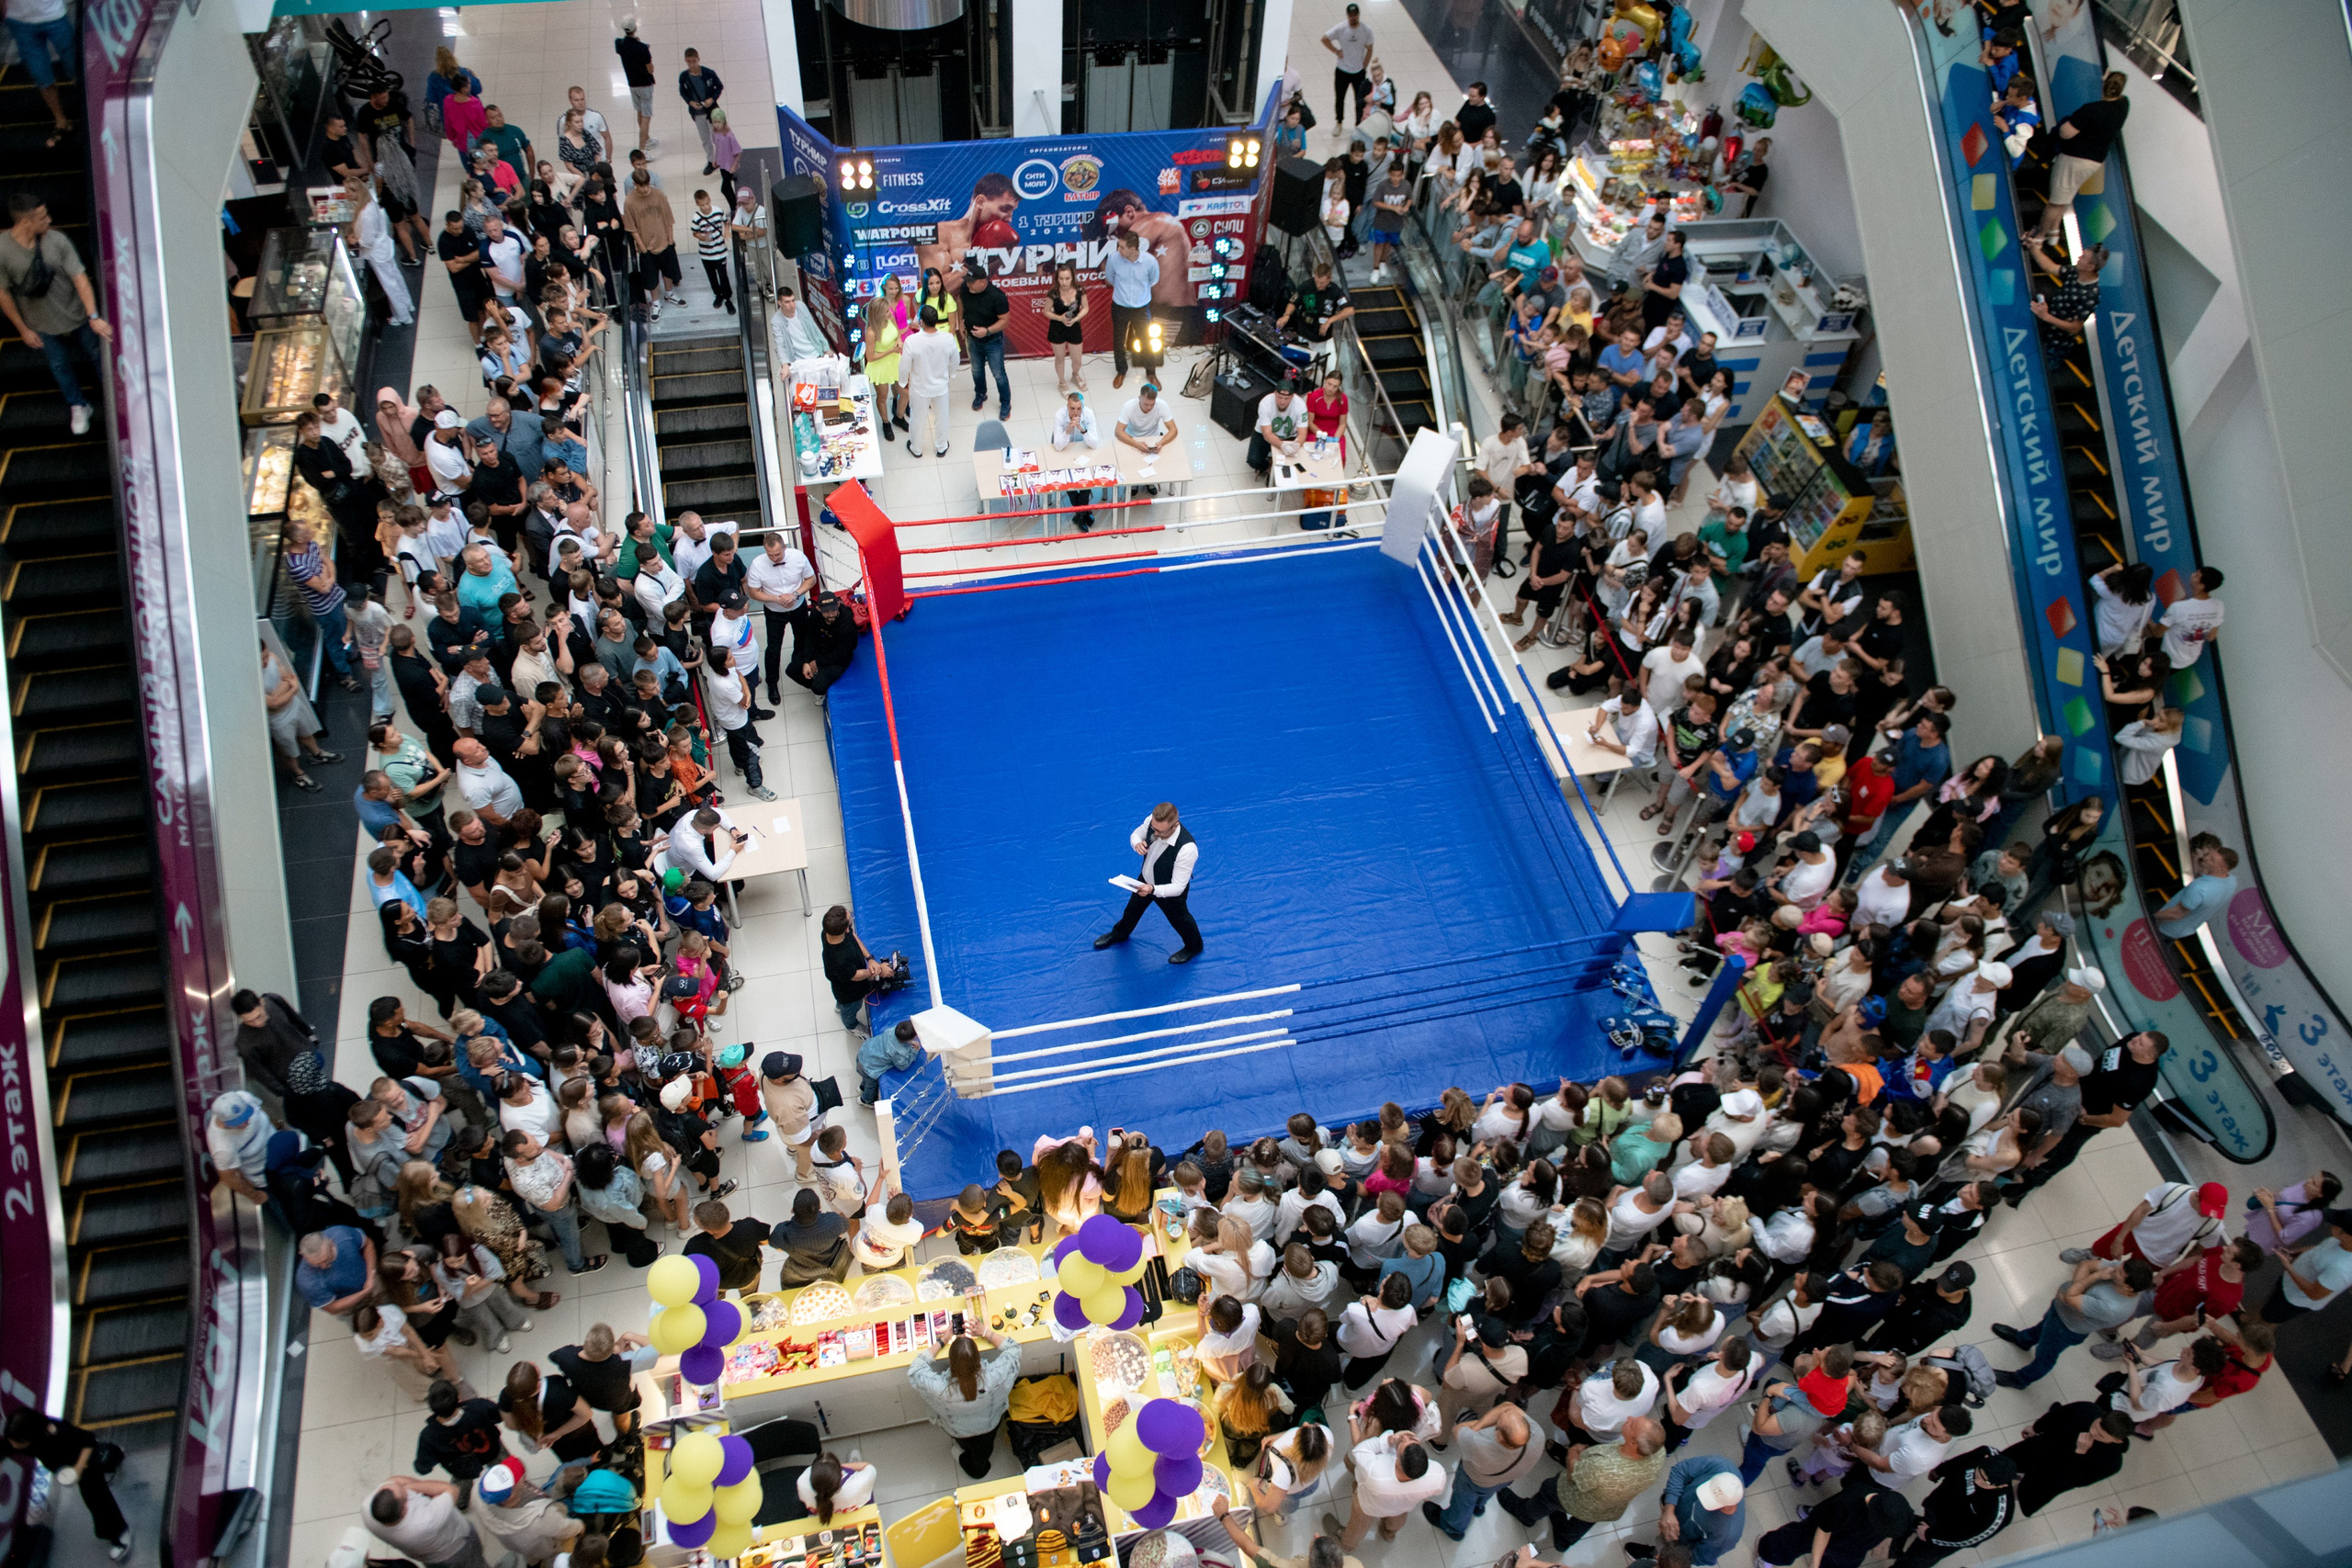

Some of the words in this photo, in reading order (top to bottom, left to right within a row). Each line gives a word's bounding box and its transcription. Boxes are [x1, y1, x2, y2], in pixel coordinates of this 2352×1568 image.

[877, 198, 952, 214] CrossXit
[883, 173, 924, 186] FITNESS
[1065, 191, 1100, 202] БАТЫР
[854, 226, 935, 241] WARPOINT
[1019, 216, 1028, 228] 1
[1035, 211, 1094, 227] ТУРНИР
[115, 228, 138, 352] этаж
[992, 276, 1053, 289] БОЕВЫМ
[118, 355, 141, 395] 2
[2003, 326, 2051, 485] Детский
[2034, 497, 2063, 576] мир
[2110, 310, 2160, 465] Детский
[2142, 476, 2172, 553] мир
[122, 455, 154, 662] БОЛЬШОЙ
[149, 577, 176, 711] ОБУВИ
[142, 671, 173, 826] САМЫЙ
[166, 719, 190, 847] МАГАЗИН
[2300, 1014, 2327, 1046] 3
[2189, 1050, 2219, 1082] 3
[2207, 1089, 2250, 1152] этаж
[6, 1180, 33, 1222] 2
[188, 1248, 240, 1454] kari
